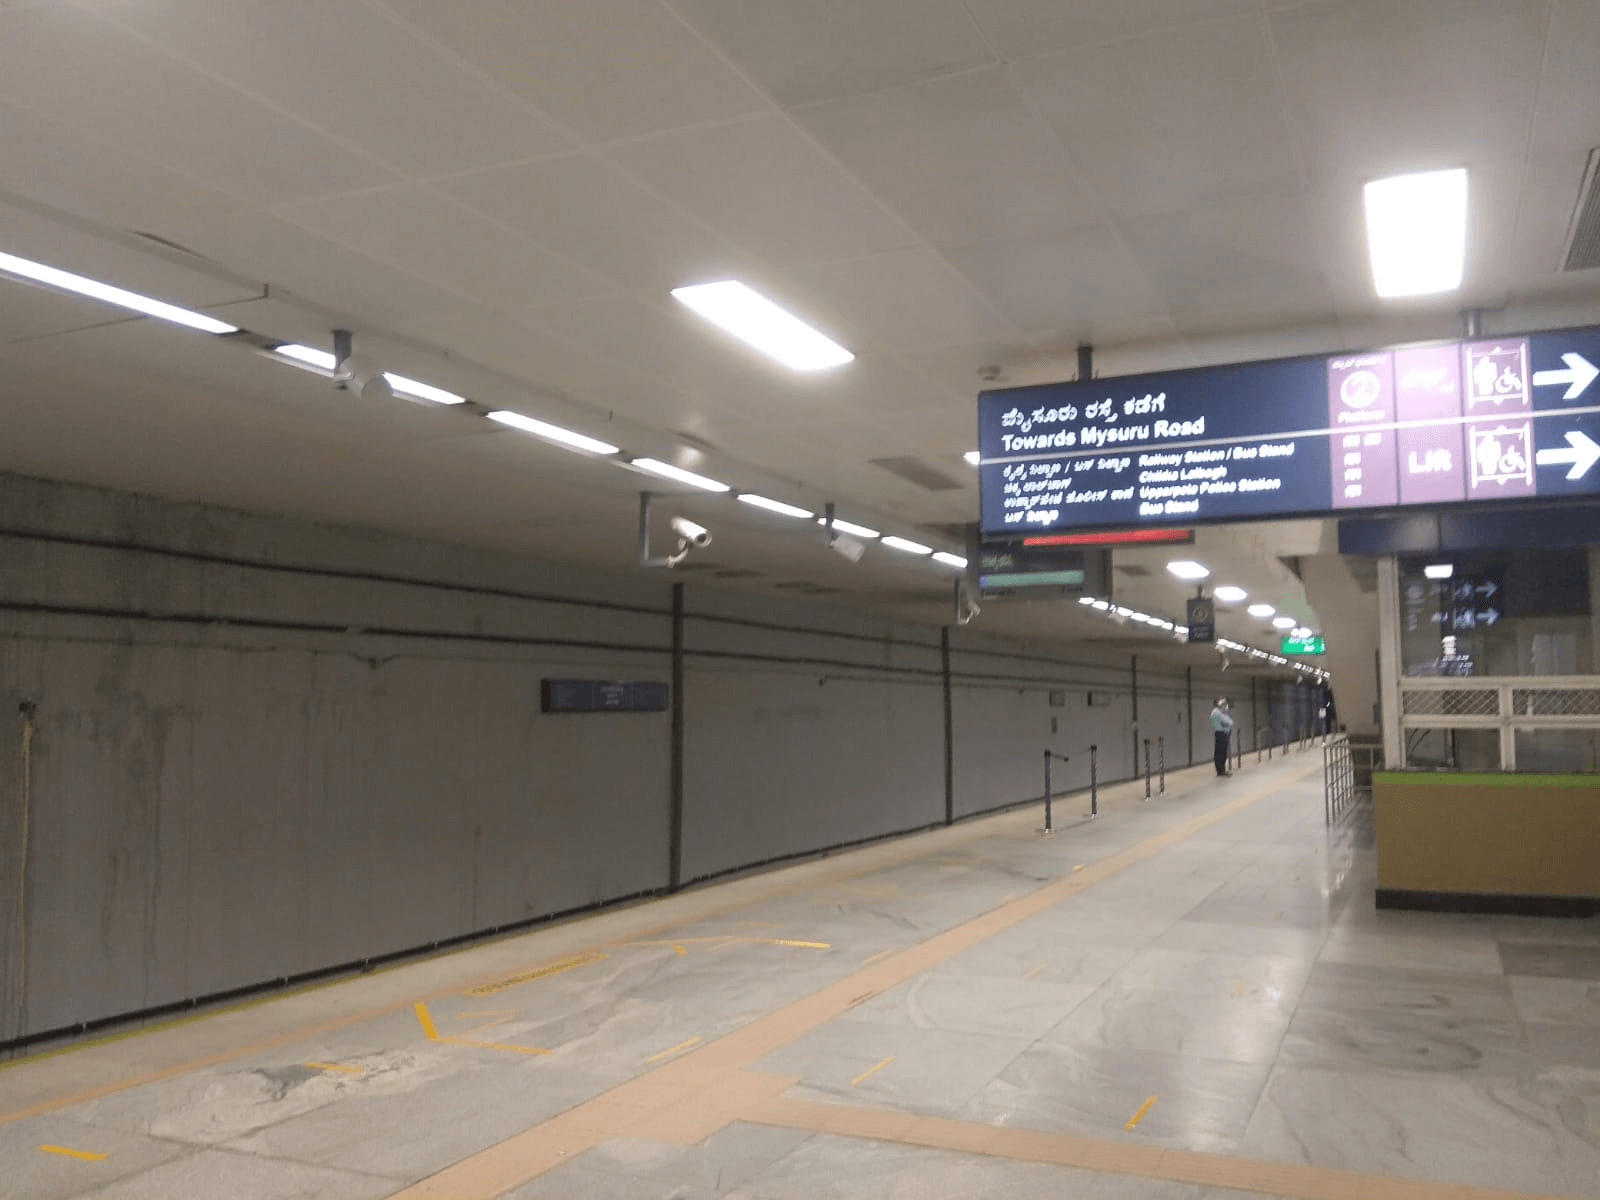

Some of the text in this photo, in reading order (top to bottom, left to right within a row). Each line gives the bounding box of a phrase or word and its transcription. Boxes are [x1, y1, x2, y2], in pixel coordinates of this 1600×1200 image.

[1085, 398, 1118, 422] ರಸ್ತೆ
[1002, 416, 1205, 452] Towards Mysuru Road
[1139, 453, 1183, 467] Railway
[1184, 449, 1225, 463] Station
[1233, 447, 1257, 459] Bus
[1259, 442, 1294, 457] Stand
[1238, 477, 1281, 492] Station
